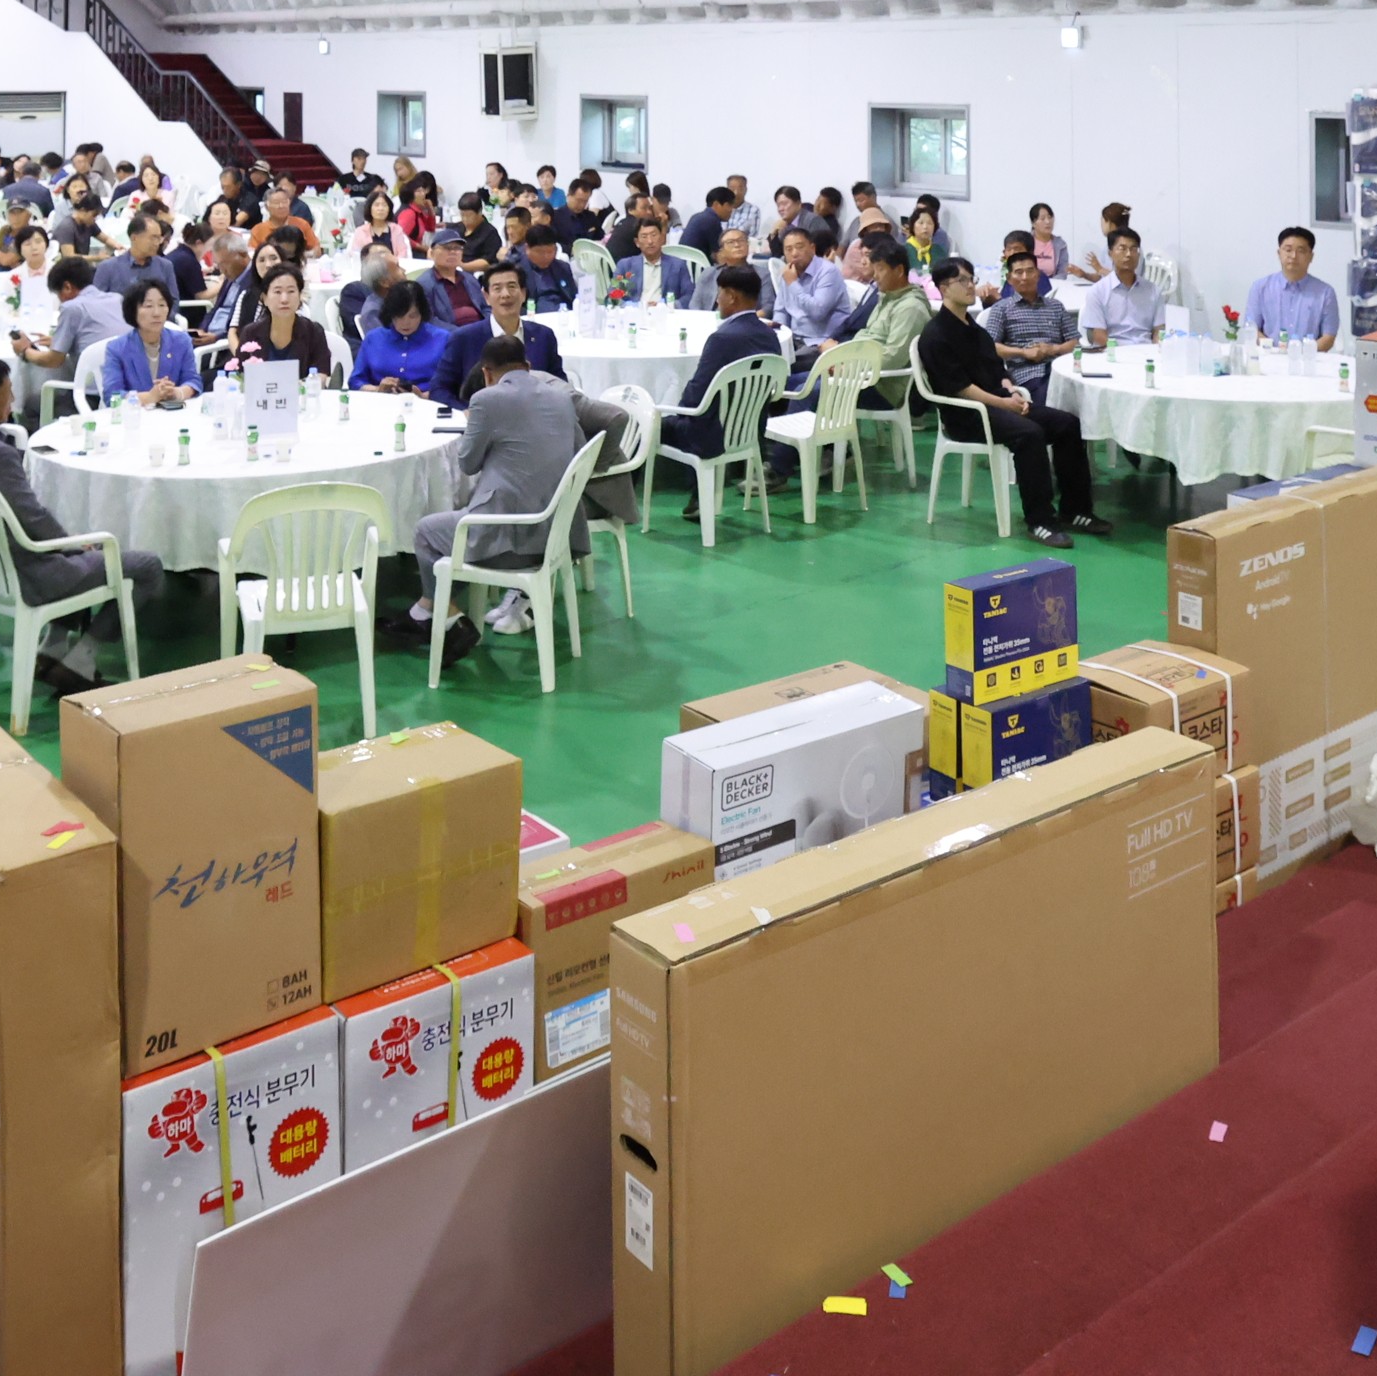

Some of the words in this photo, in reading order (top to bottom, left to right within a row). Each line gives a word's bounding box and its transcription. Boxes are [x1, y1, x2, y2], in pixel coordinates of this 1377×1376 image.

[1239, 541, 1306, 578] ZENOS
[725, 772, 769, 794] BLACK+
[725, 782, 769, 805] DECKER
[720, 809, 746, 826] Electric
[747, 805, 762, 818] Fan
[1127, 824, 1152, 856] Full
[1154, 817, 1173, 842] HD
[1175, 808, 1194, 834] TV
[282, 970, 308, 989] 8AH
[282, 985, 313, 1005] 12AH
[470, 997, 514, 1033] 분무기
[145, 1028, 178, 1058] 20L
[385, 1042, 407, 1062] 하마
[265, 1064, 316, 1104] 분무기
[481, 1066, 514, 1089] 배터리
[167, 1118, 192, 1139] 하마
[279, 1118, 318, 1144] 대용량
[279, 1138, 318, 1164] 배터리
